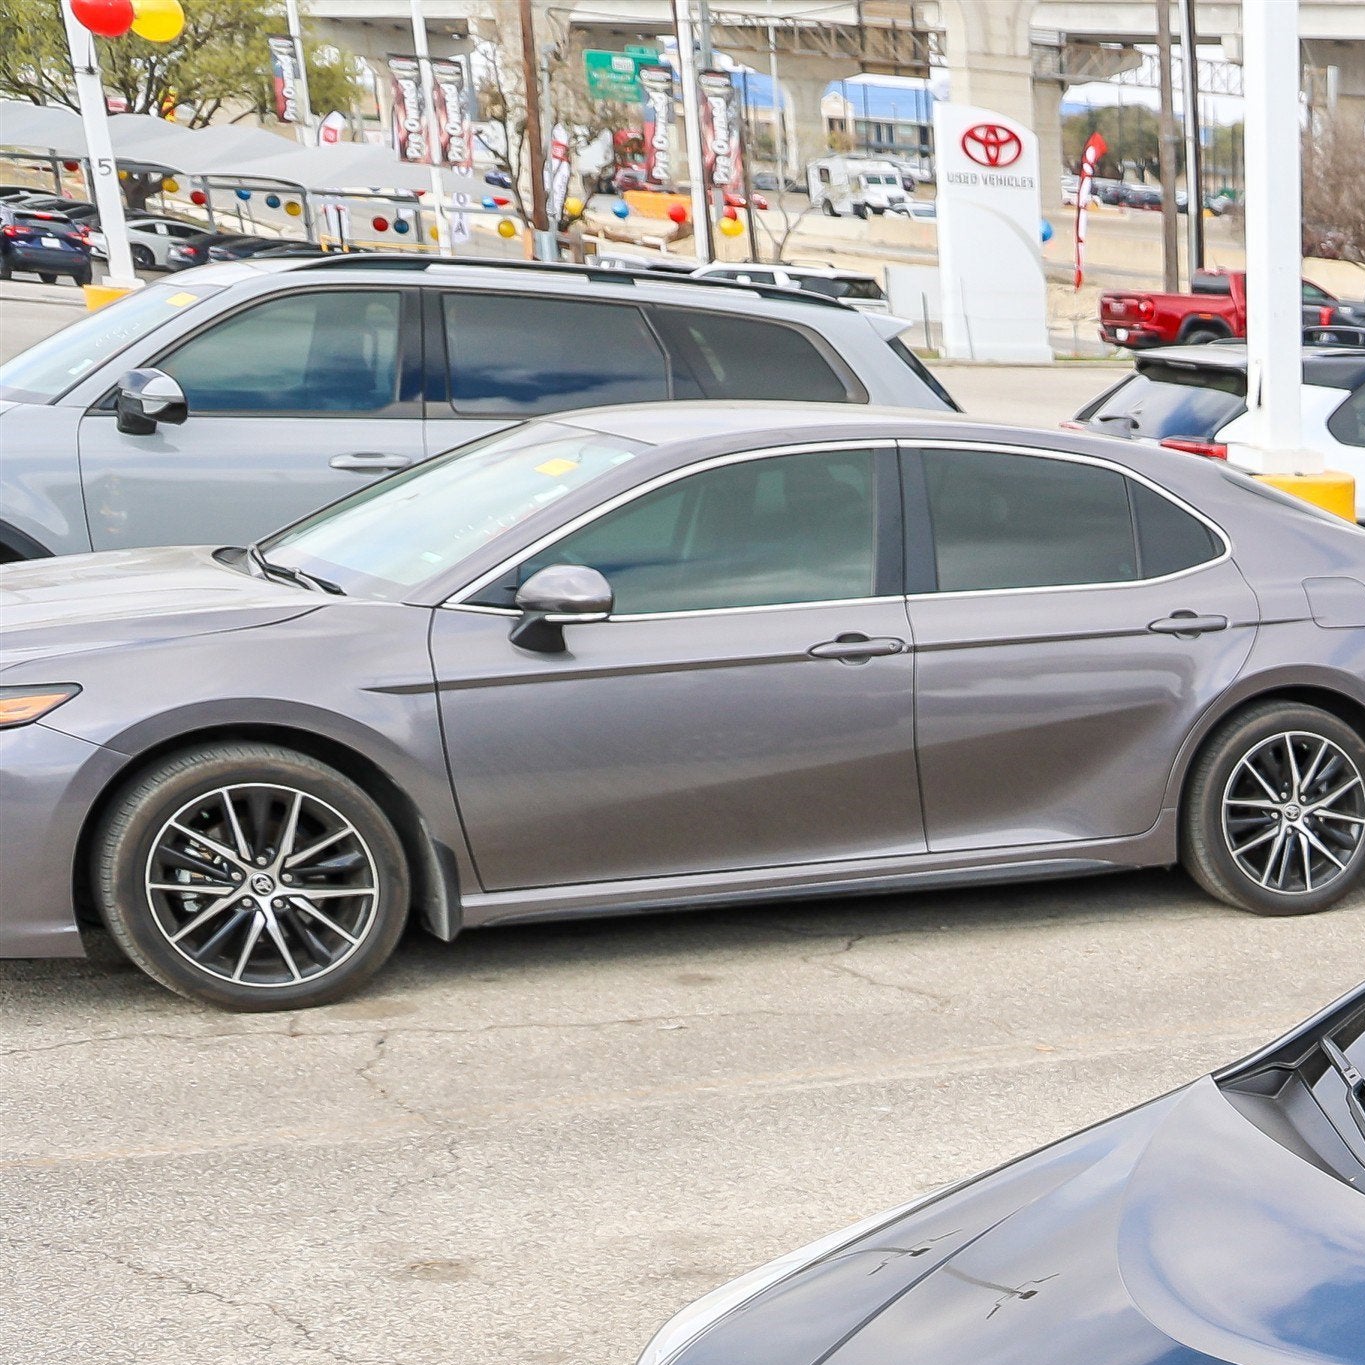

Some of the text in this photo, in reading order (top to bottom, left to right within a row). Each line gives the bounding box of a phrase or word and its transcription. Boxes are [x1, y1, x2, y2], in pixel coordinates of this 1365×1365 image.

[398, 79, 420, 132] Owned
[440, 84, 463, 136] Owned
[649, 91, 669, 150] Owned
[707, 97, 730, 155] Owned
[406, 132, 425, 158] Pre
[448, 136, 466, 161] Pre
[98, 157, 112, 177] 5
[652, 150, 670, 180] Pre
[713, 155, 731, 185] Pre
[981, 172, 1034, 189] VEHICLES
